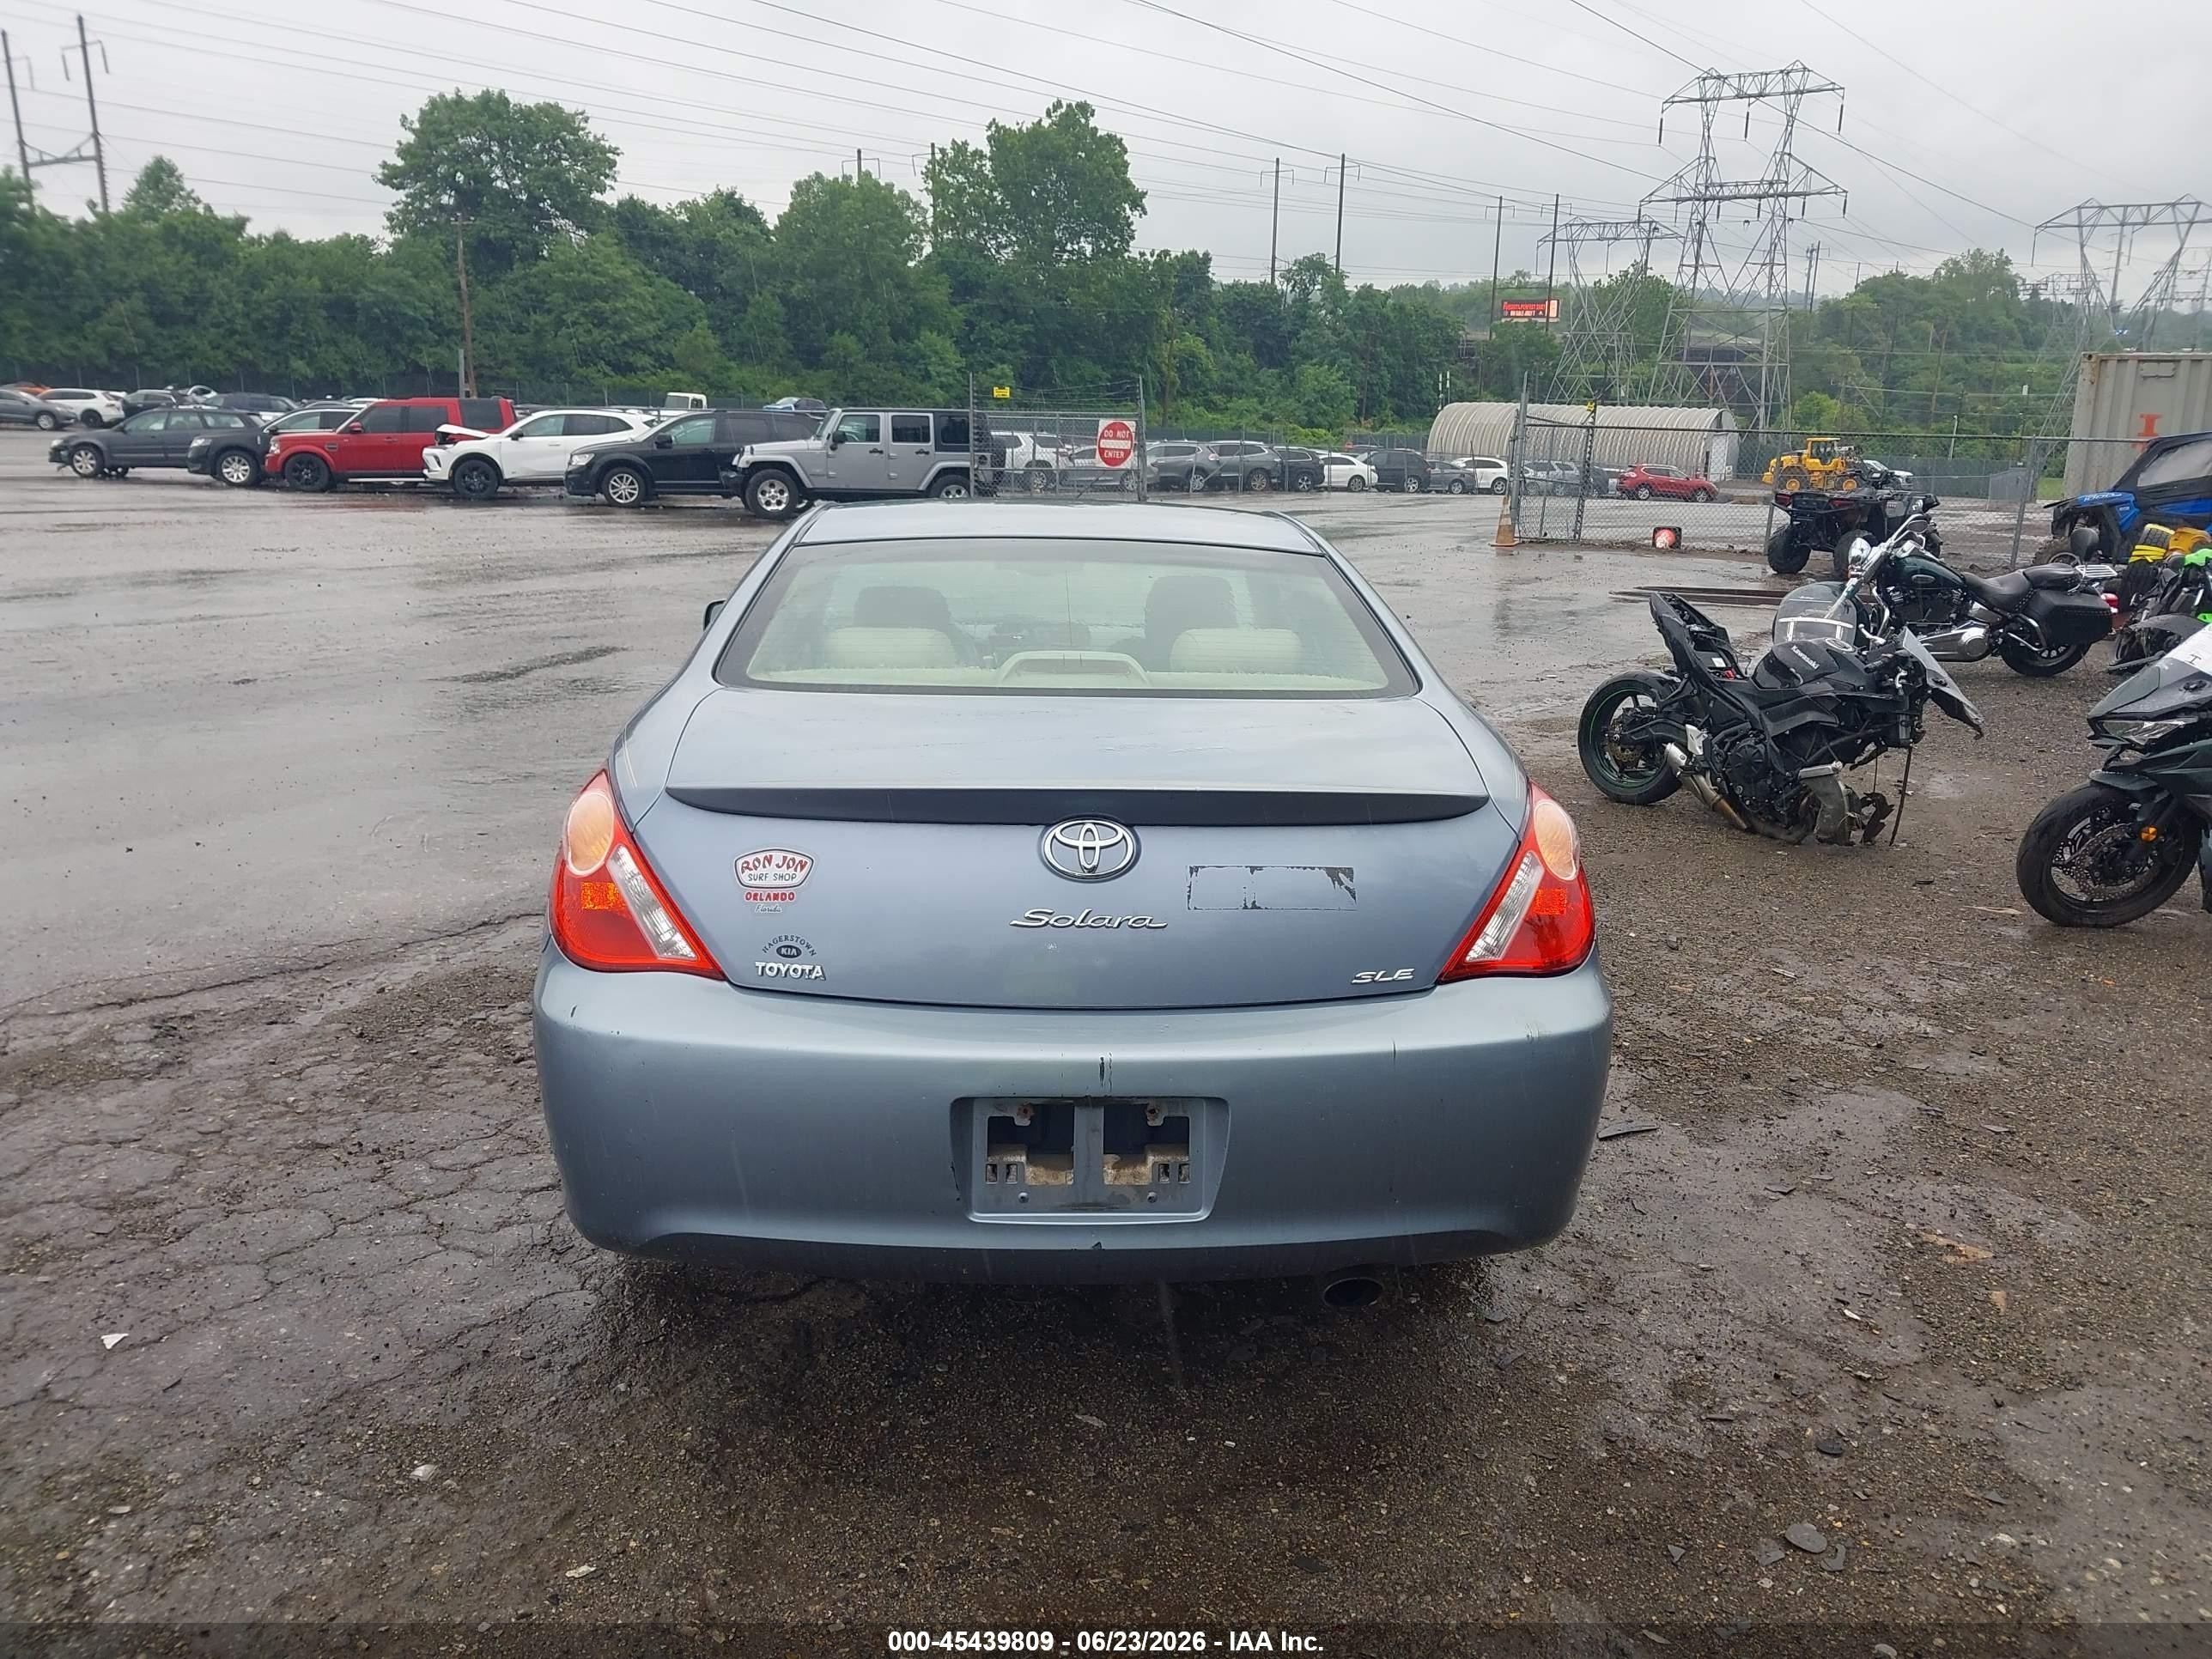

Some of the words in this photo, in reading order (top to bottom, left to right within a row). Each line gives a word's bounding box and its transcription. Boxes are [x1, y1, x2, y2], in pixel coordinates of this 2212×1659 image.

[1103, 429, 1114, 438] DO
[1116, 430, 1130, 439] NOT
[1104, 450, 1125, 459] ENTER
[1790, 645, 1820, 670] Kawasaki
[741, 854, 774, 874] RON
[775, 855, 808, 872] JON
[748, 872, 769, 882] SURF
[773, 872, 797, 882] SHOP
[744, 891, 795, 902] ORLANDO
[1009, 908, 1169, 929] Solara
[762, 934, 817, 957] HAGERSTOWN
[781, 947, 798, 957] KIA
[755, 961, 826, 981] TOYOTA
[1351, 968, 1415, 984] SLE
